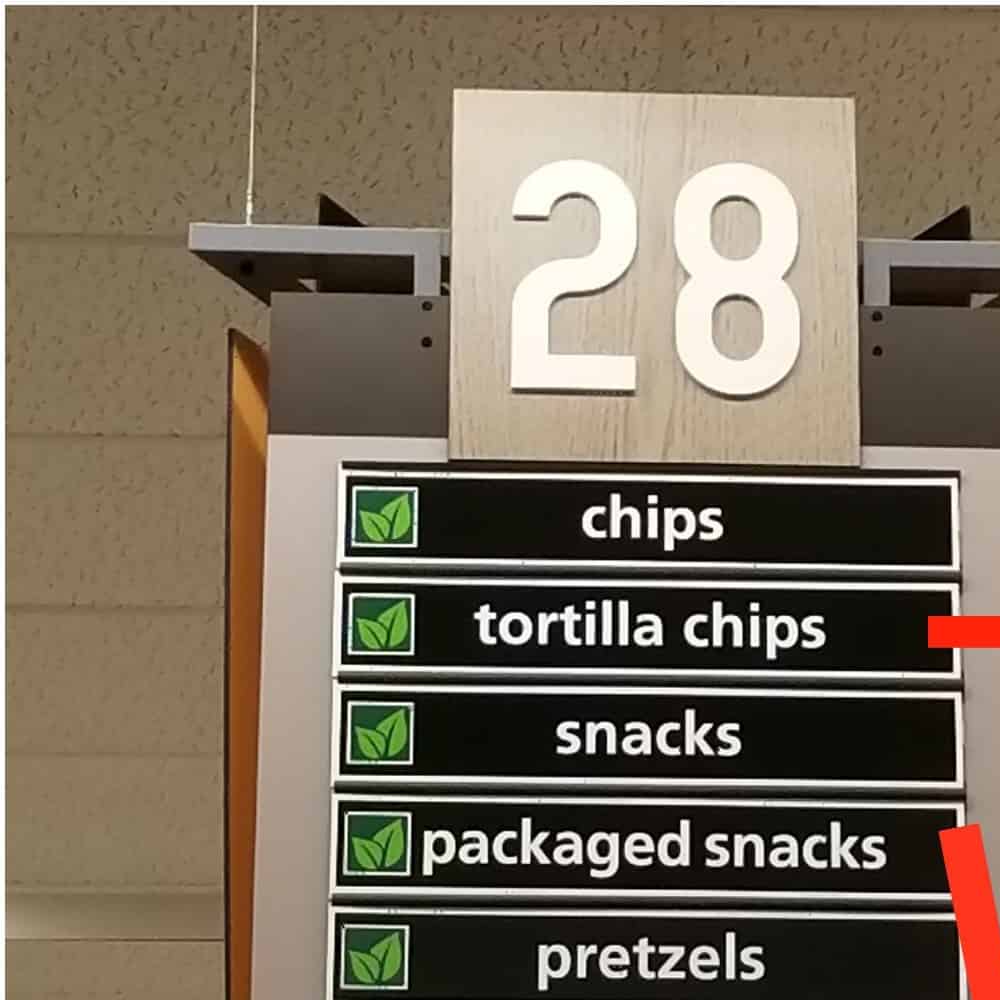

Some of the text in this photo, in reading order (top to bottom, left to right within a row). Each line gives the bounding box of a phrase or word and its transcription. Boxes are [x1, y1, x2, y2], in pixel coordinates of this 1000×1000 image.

[511, 159, 800, 397] 28
[581, 493, 724, 551] chips
[474, 601, 827, 660] tortilla chips
[555, 709, 742, 756] snacks
[422, 819, 887, 877] packaged snacks
[537, 932, 766, 991] pretzels
